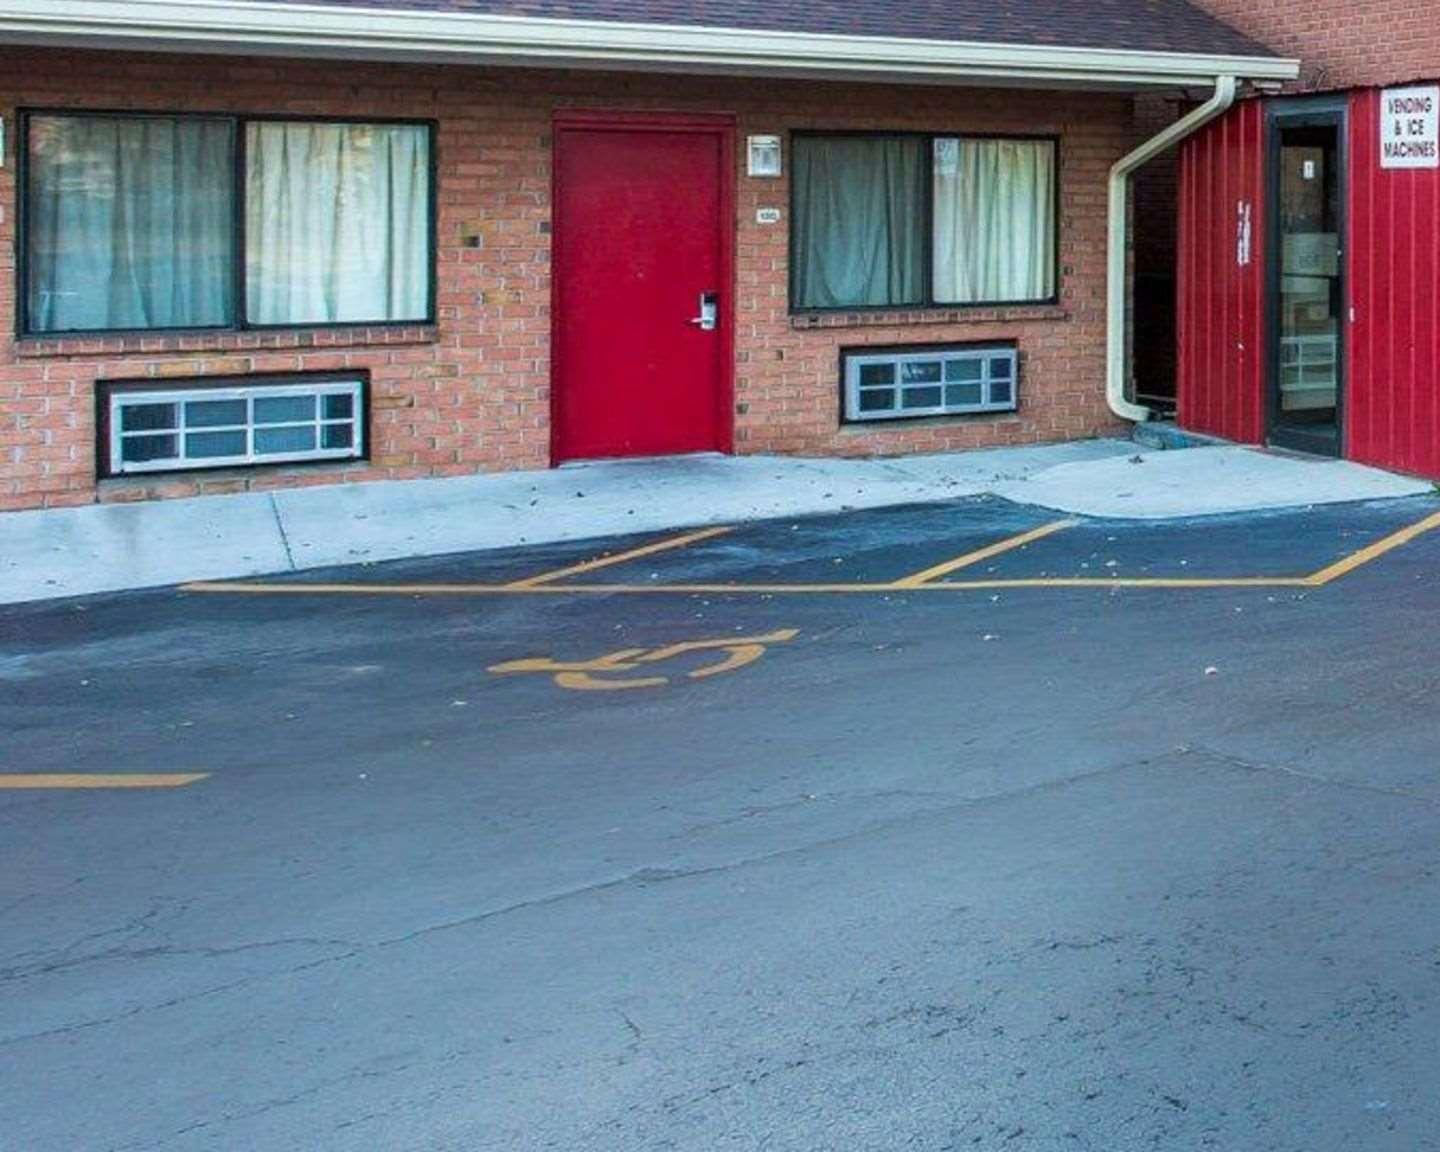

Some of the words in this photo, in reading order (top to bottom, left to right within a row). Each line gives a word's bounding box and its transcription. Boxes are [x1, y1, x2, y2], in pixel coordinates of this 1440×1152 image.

[1388, 96, 1432, 114] VENDING
[1394, 119, 1402, 136] &
[1407, 118, 1424, 136] ICE
[1384, 141, 1436, 158] MACHINES
